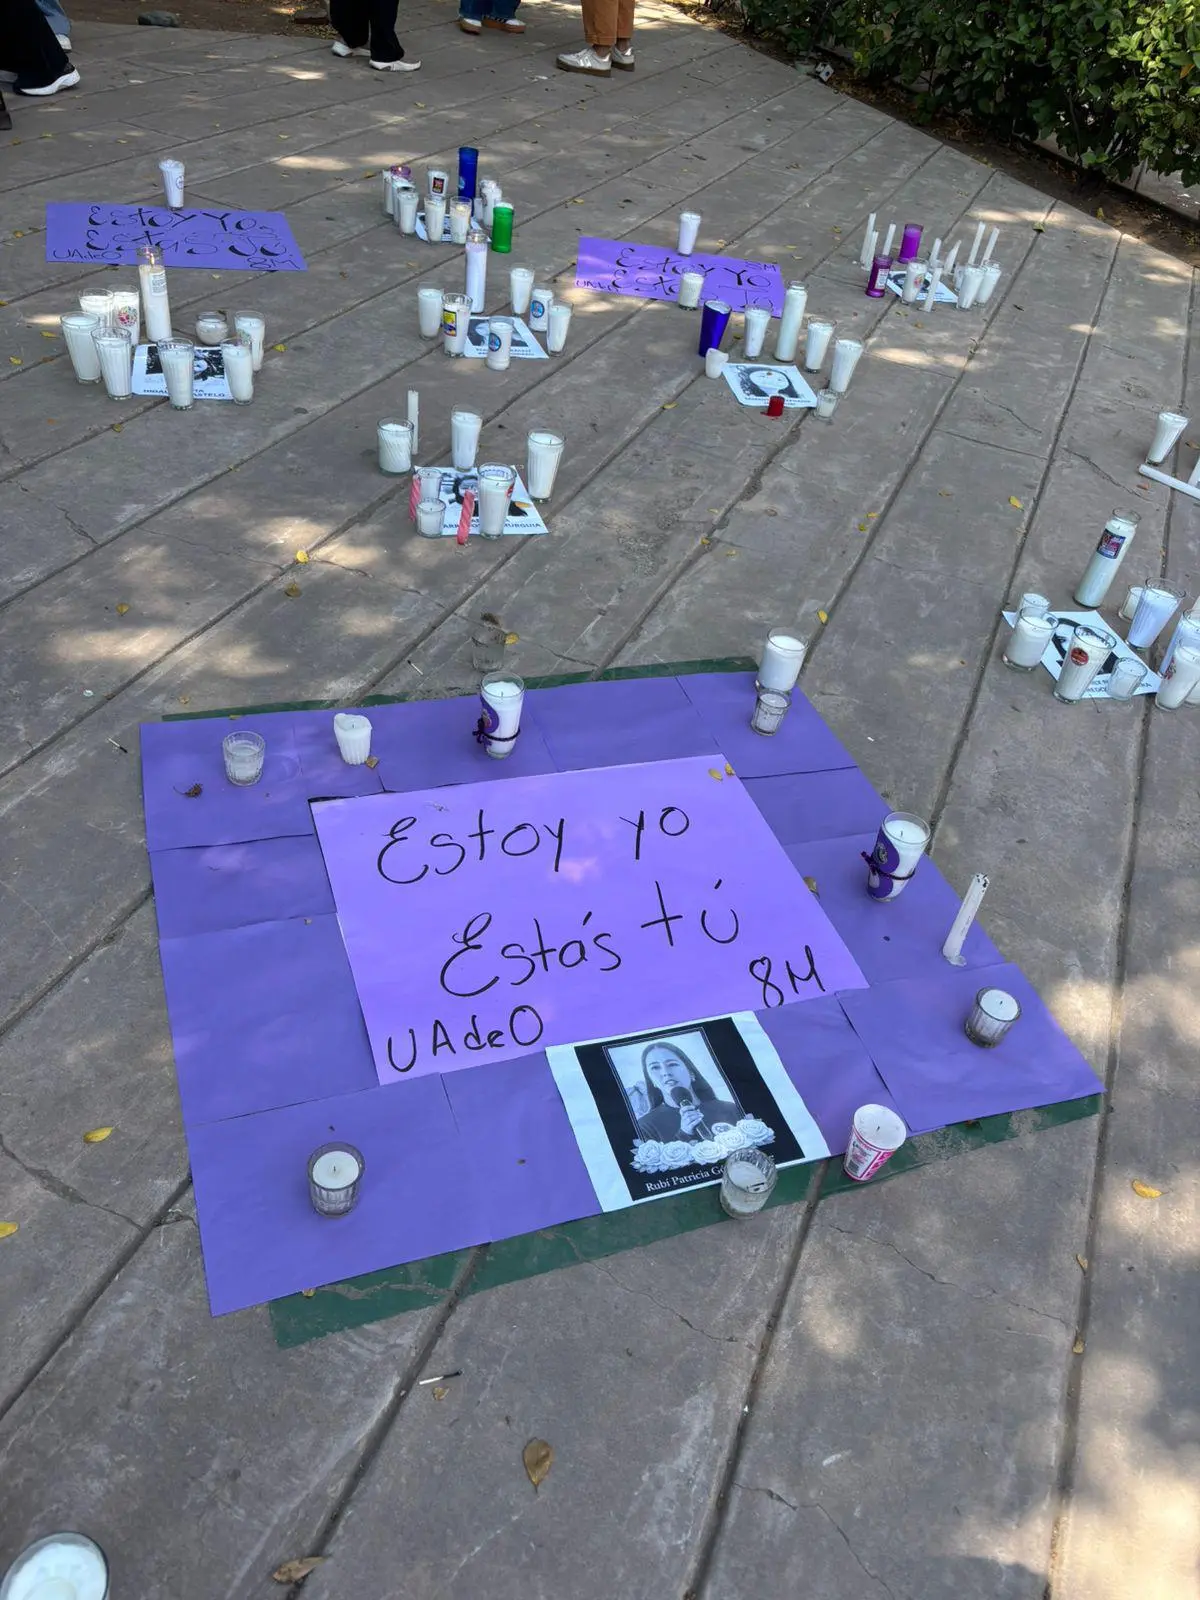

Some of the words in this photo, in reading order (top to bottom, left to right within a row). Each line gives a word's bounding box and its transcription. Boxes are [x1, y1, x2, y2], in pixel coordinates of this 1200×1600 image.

[377, 810, 565, 884] Estoy
[619, 806, 690, 860] yo
[439, 910, 622, 997] Estás
[640, 879, 741, 947] tú
[748, 945, 827, 1008] 8M
[387, 1004, 544, 1072] UAdeO
[645, 1178, 672, 1192] Rubí
[671, 1170, 709, 1185] Patricia
